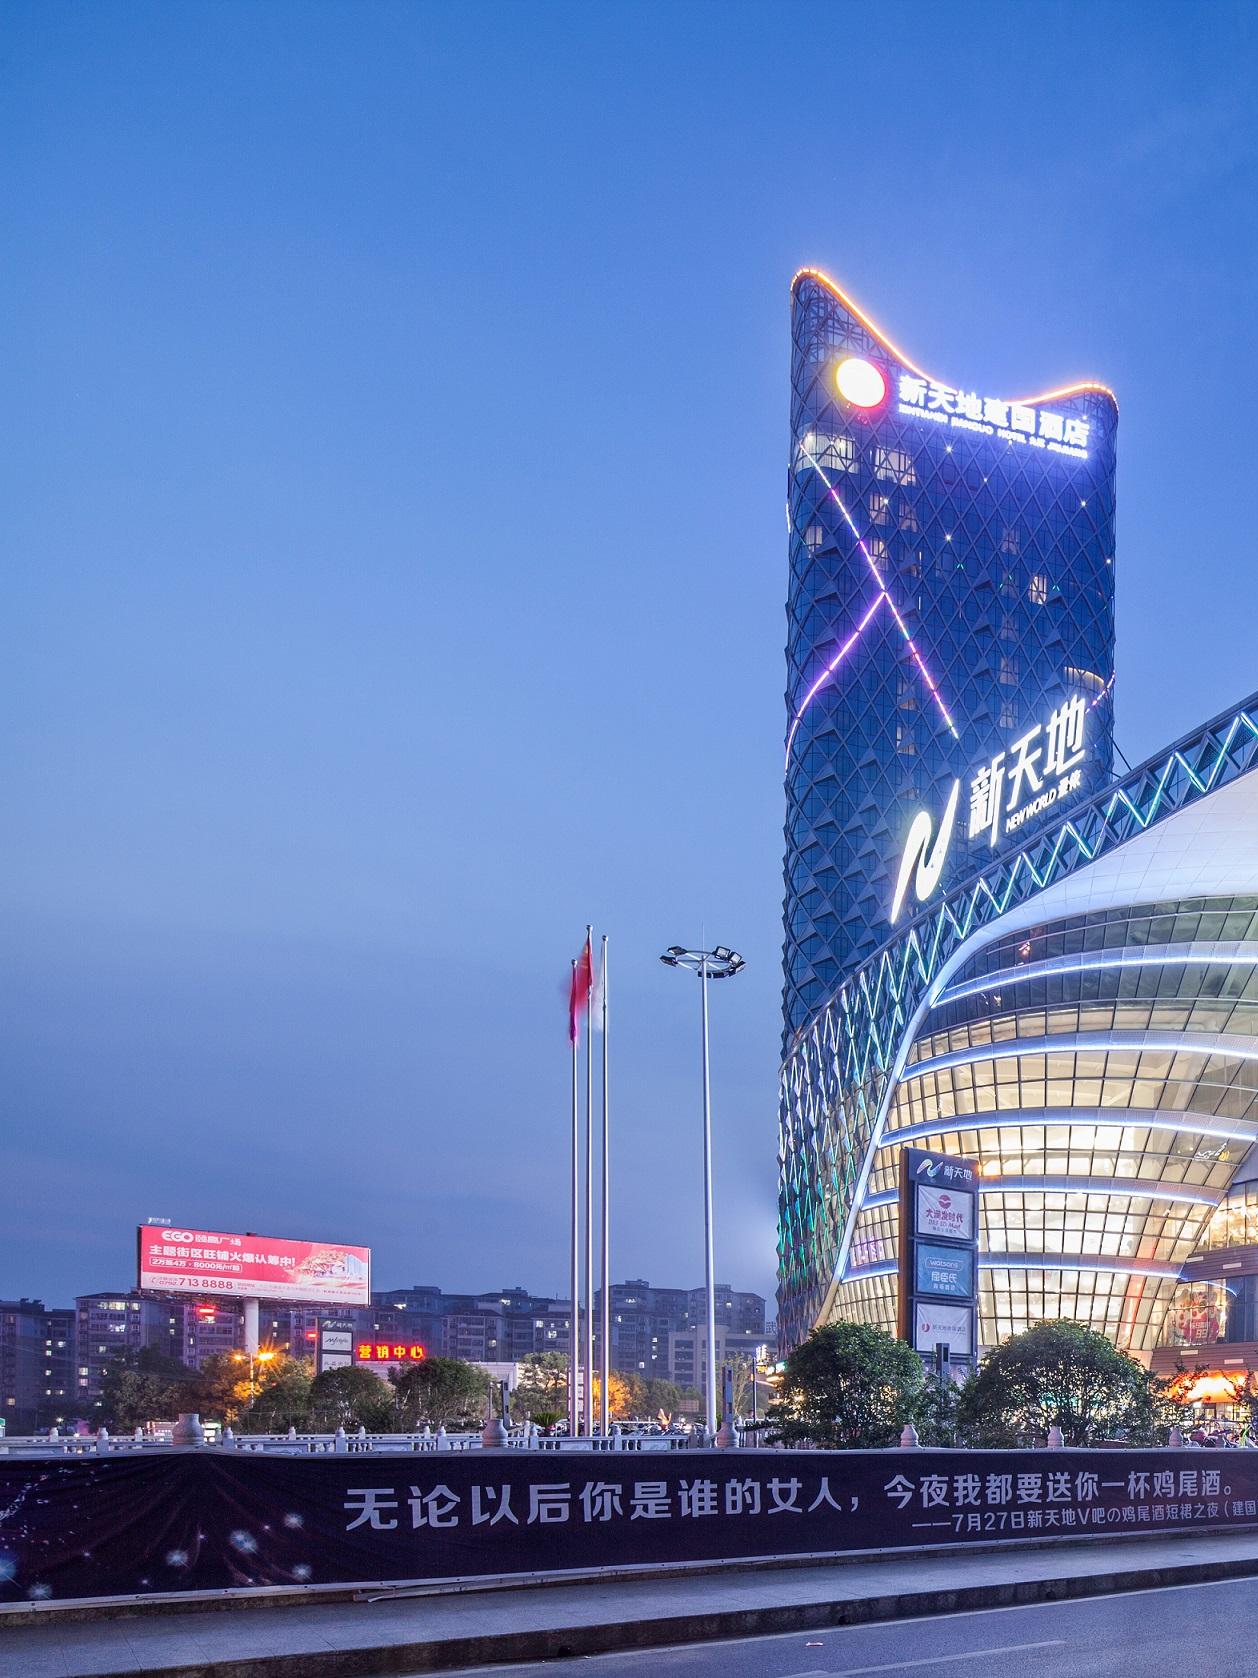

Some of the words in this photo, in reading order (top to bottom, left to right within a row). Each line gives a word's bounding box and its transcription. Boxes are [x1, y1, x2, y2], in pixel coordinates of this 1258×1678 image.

[899, 375, 1089, 447] 新天地建国酒店
[968, 694, 1086, 847] 新天地
[944, 1166, 973, 1180] 新天地
[161, 1230, 194, 1243] EGO
[179, 1278, 199, 1287] 713
[201, 1280, 233, 1290] 8888
[931, 1271, 957, 1284] 屈臣氏
[359, 1344, 423, 1358] 营销中心
